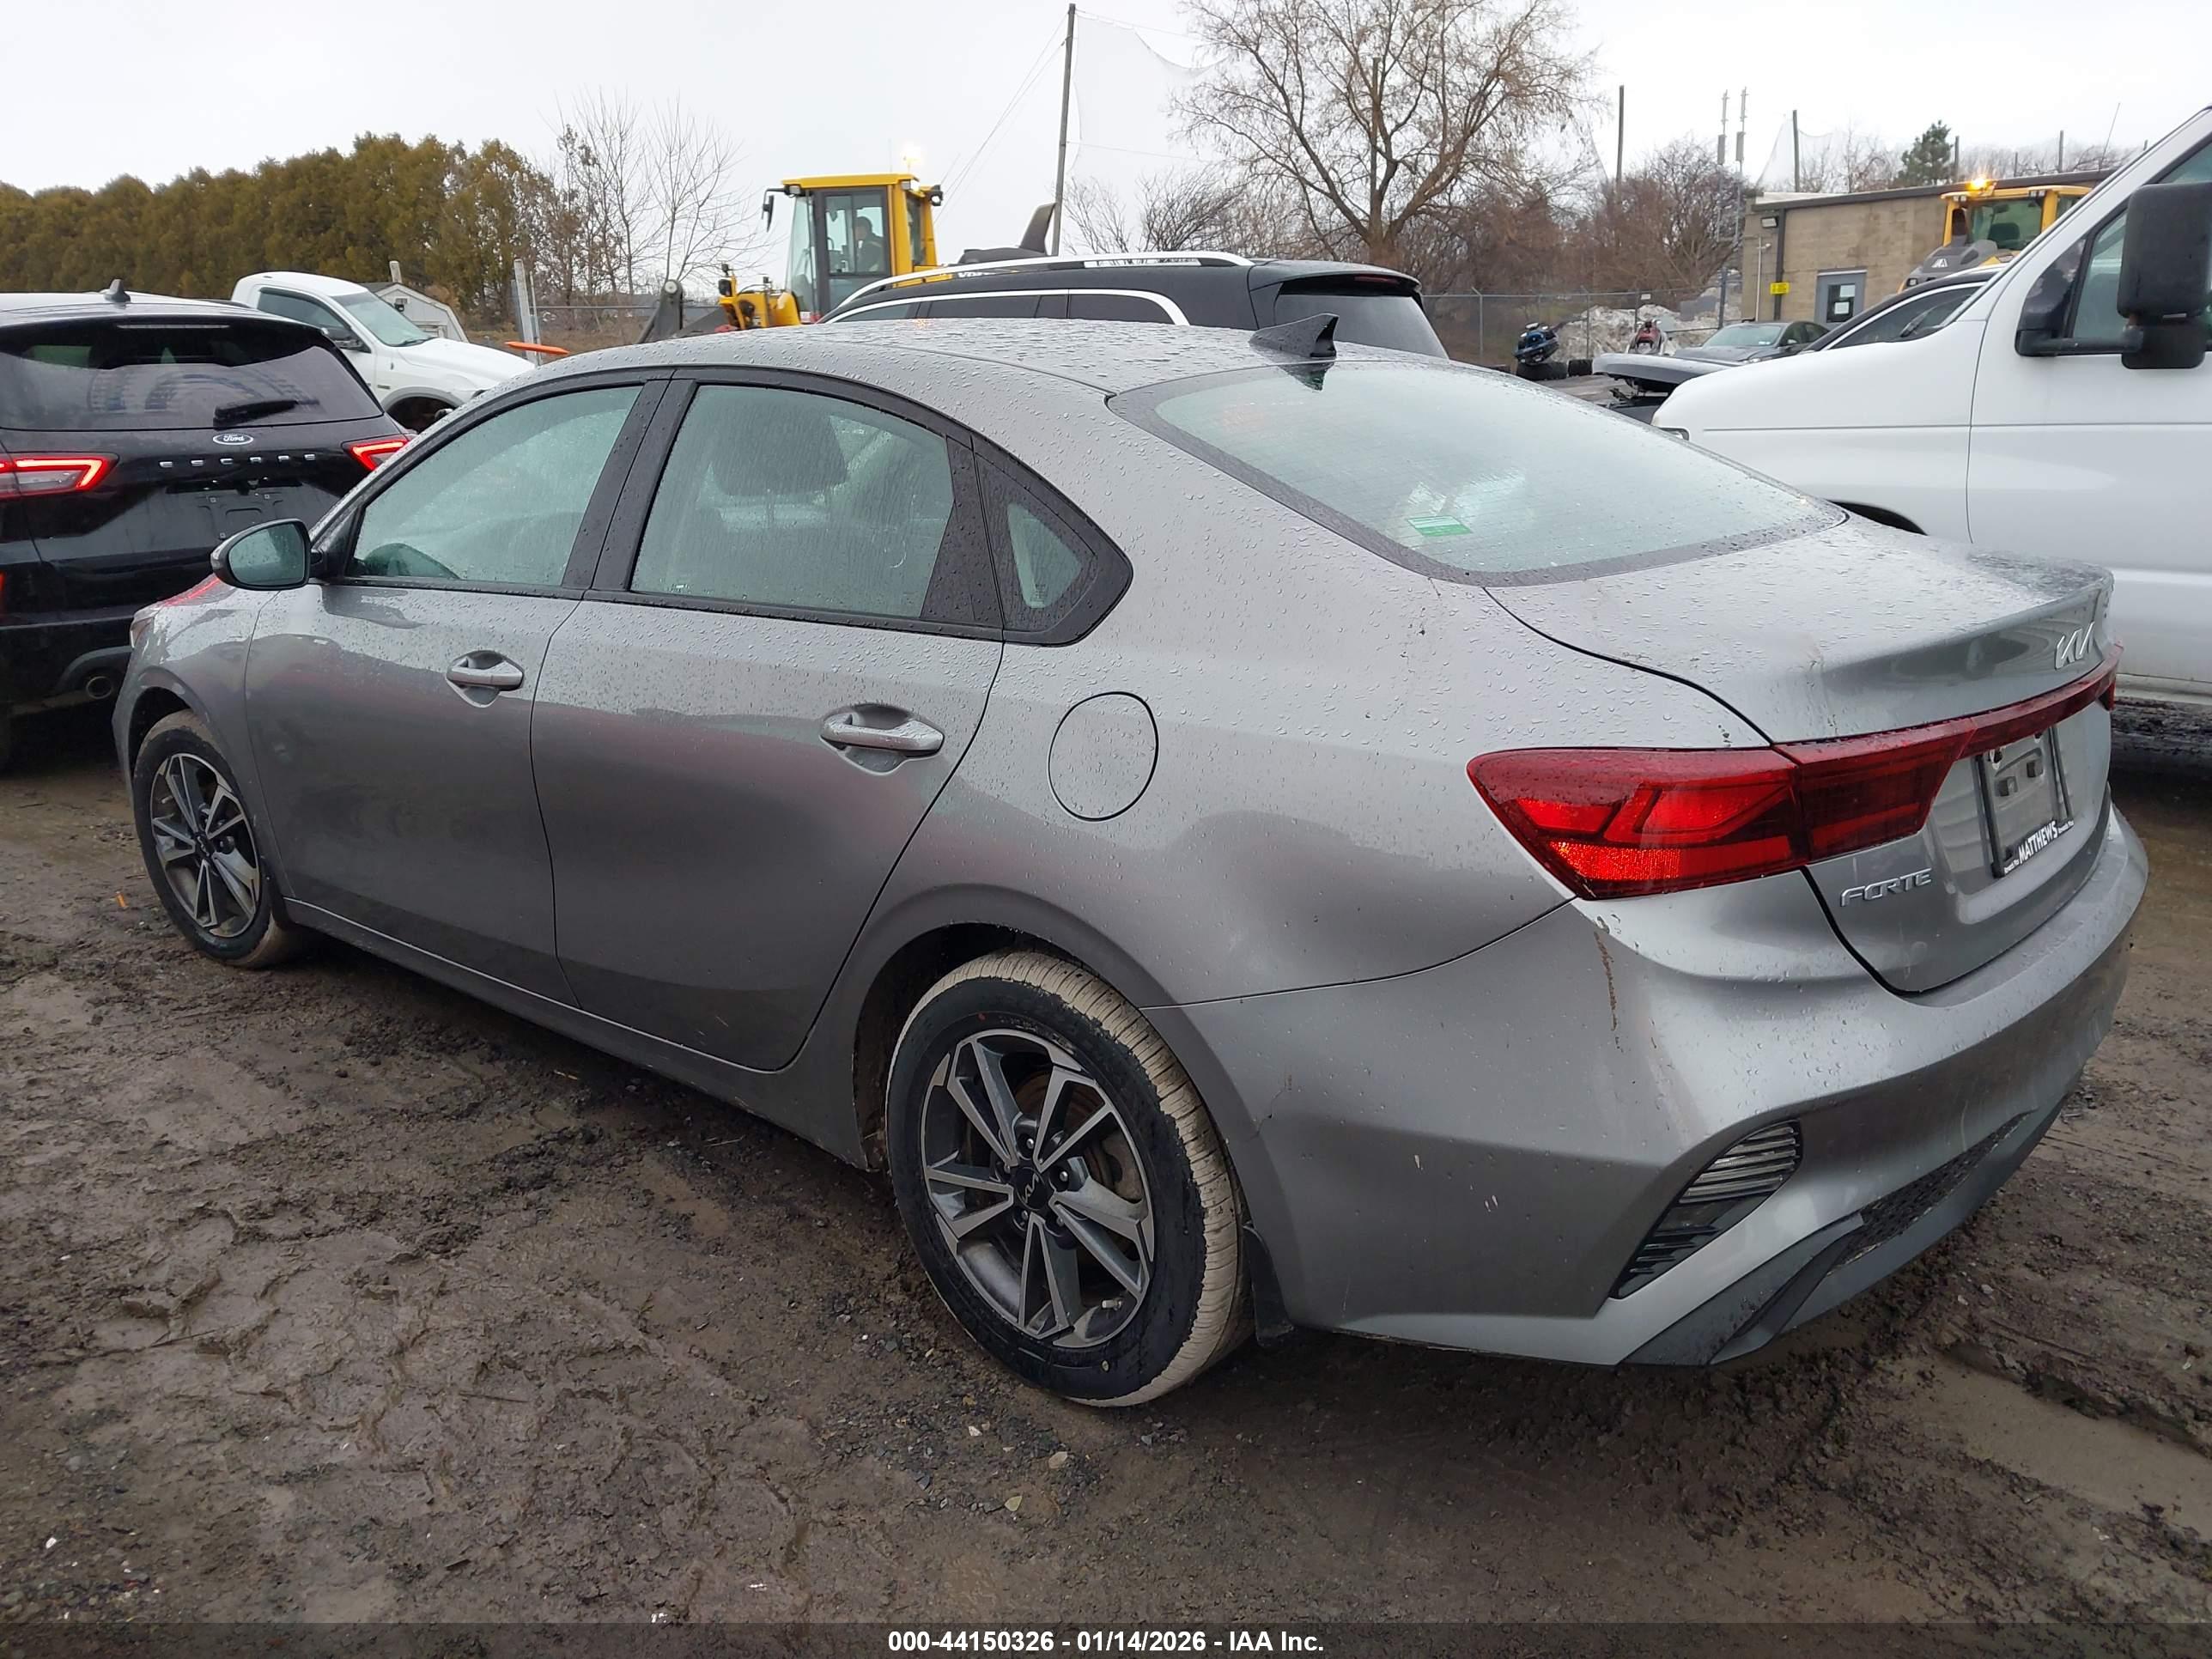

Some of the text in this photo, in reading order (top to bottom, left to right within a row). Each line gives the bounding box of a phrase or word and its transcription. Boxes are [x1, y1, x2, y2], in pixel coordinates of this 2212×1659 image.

[159, 453, 316, 468] ESCAPE
[2018, 820, 2058, 866] MATTHEWS
[1840, 867, 1932, 907] FORTE
